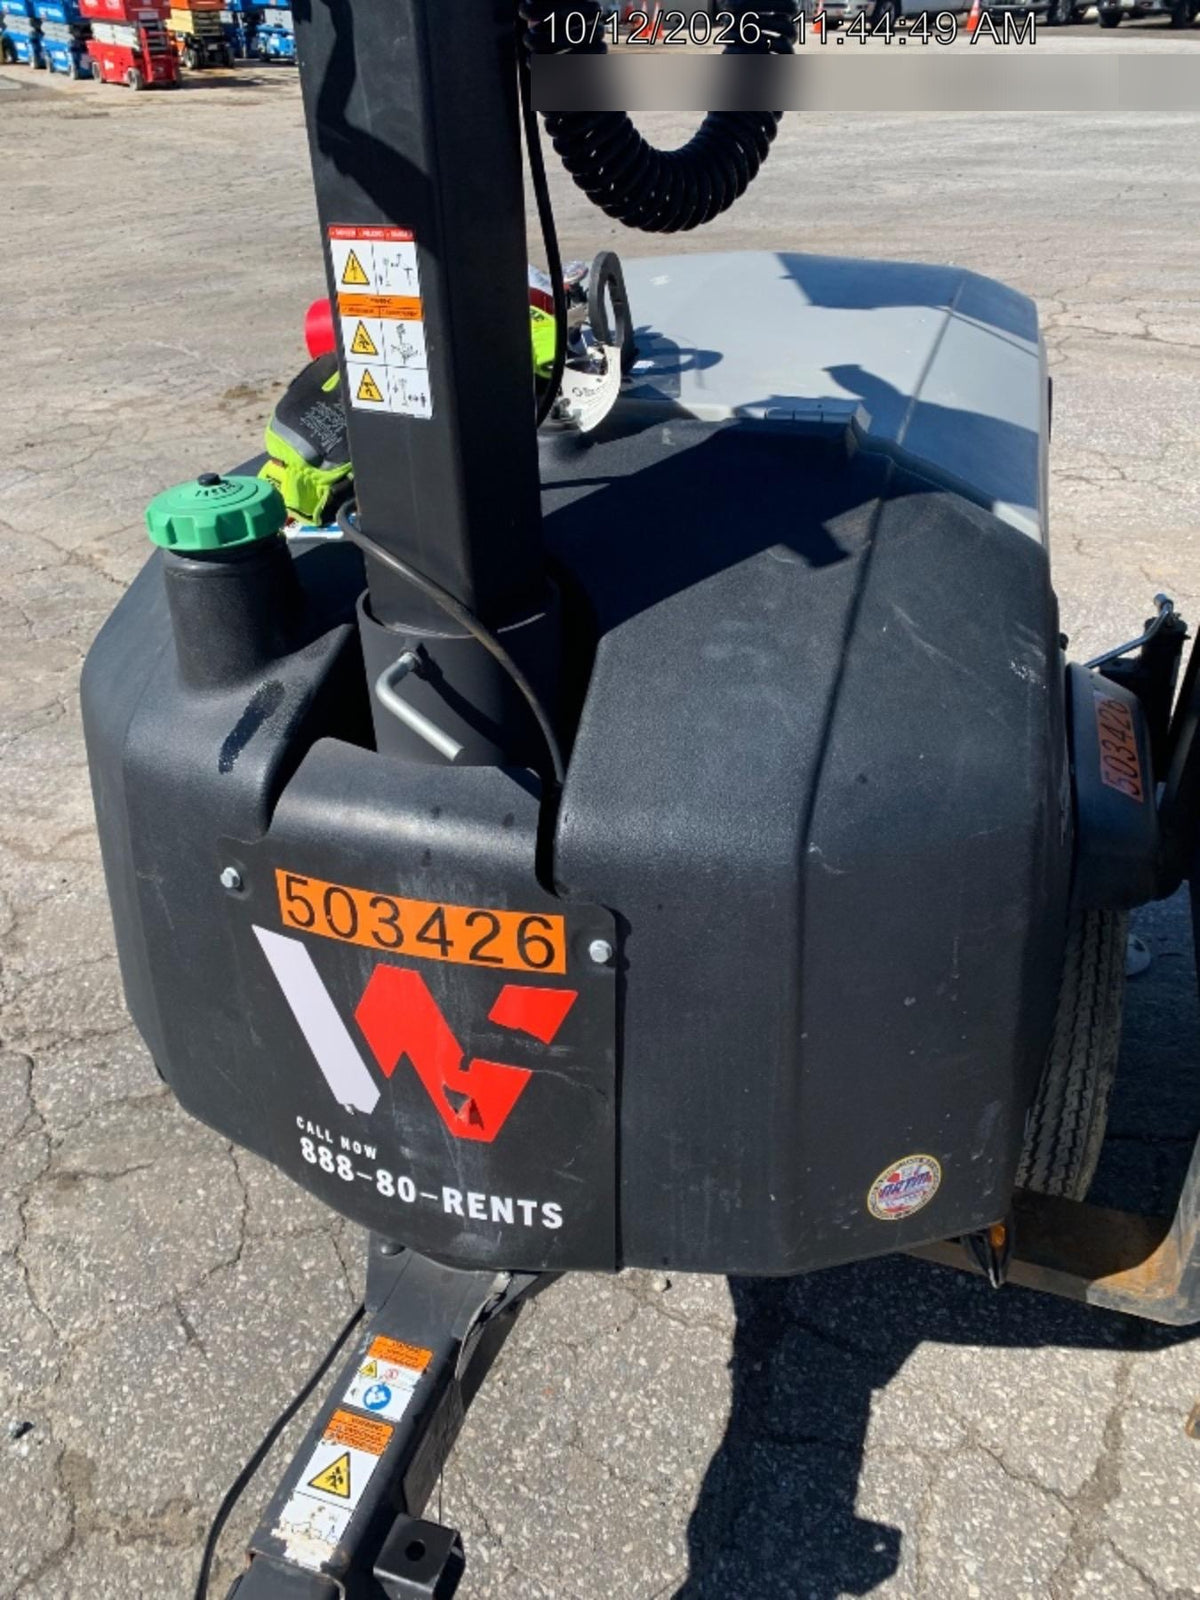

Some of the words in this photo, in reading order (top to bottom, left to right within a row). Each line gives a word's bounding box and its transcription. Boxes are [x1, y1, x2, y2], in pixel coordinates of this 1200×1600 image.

[1098, 700, 1141, 797] 503426
[284, 874, 556, 969] 503426
[296, 1116, 333, 1144] CALL
[340, 1135, 377, 1160] NOW
[300, 1136, 563, 1230] 888-80-RENTS
